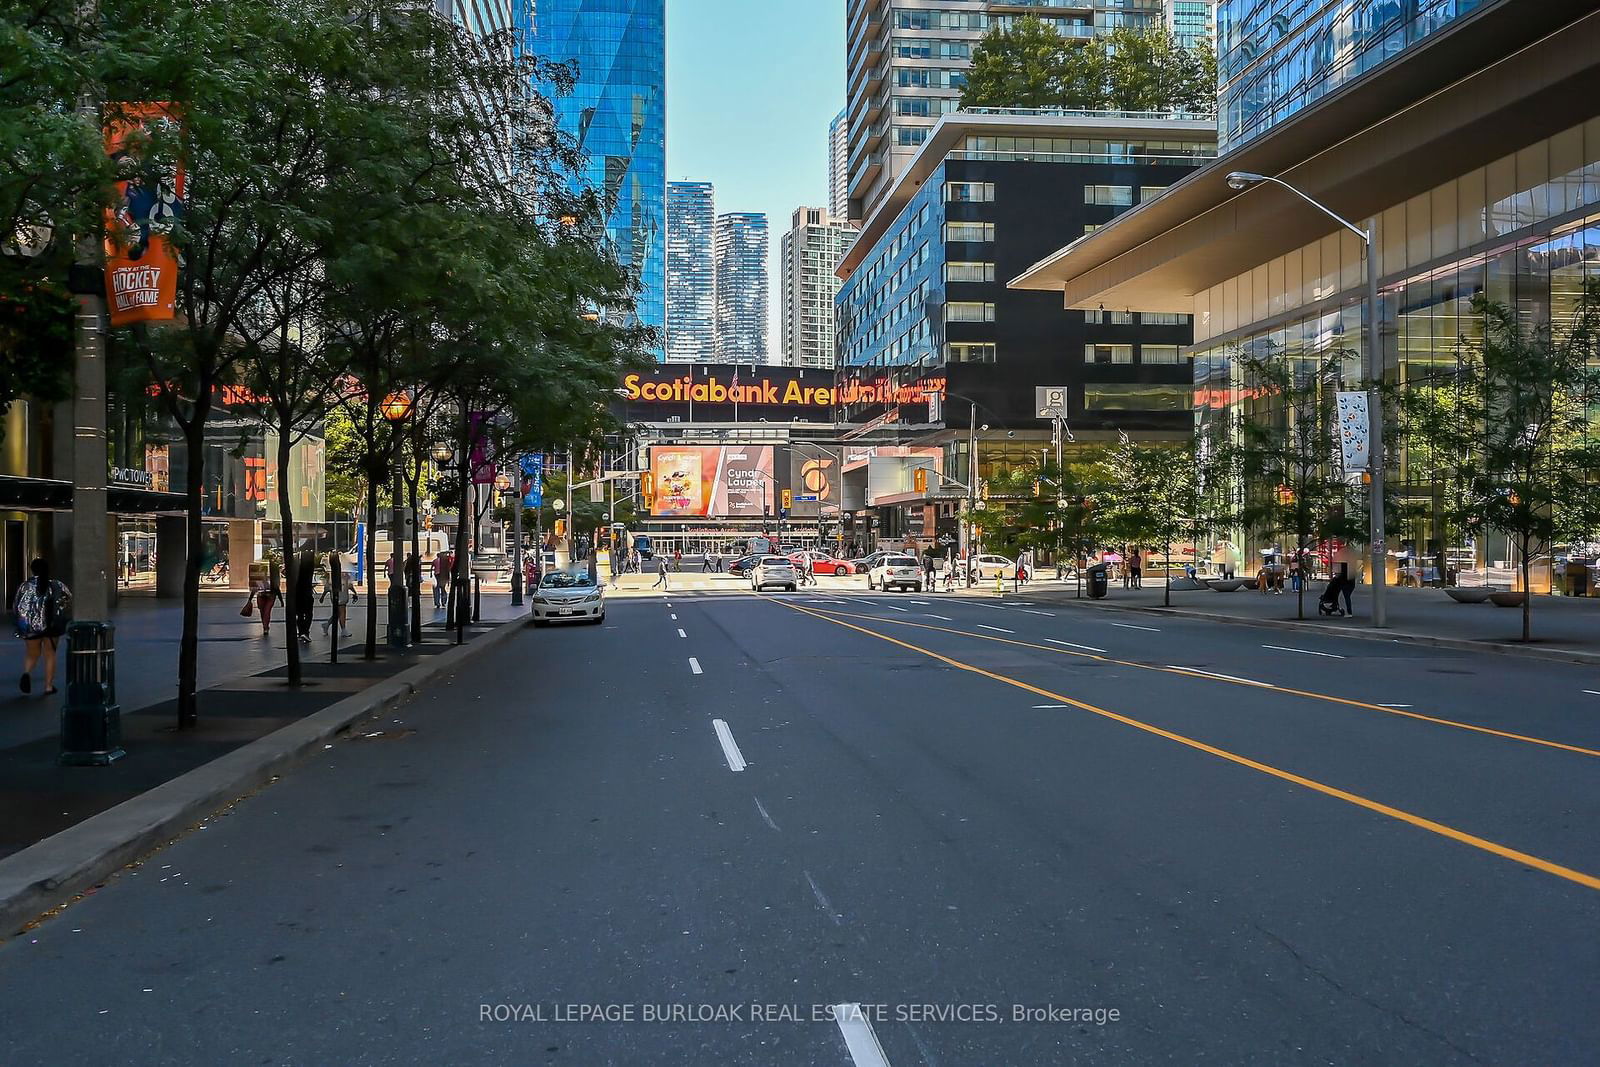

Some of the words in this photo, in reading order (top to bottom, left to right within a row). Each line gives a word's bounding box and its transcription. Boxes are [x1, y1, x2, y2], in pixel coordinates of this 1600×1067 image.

[112, 270, 160, 292] HOCKEY
[116, 294, 130, 309] HALL
[136, 291, 159, 304] FAME
[624, 374, 779, 404] Scotiabank
[727, 477, 765, 488] Lauper
